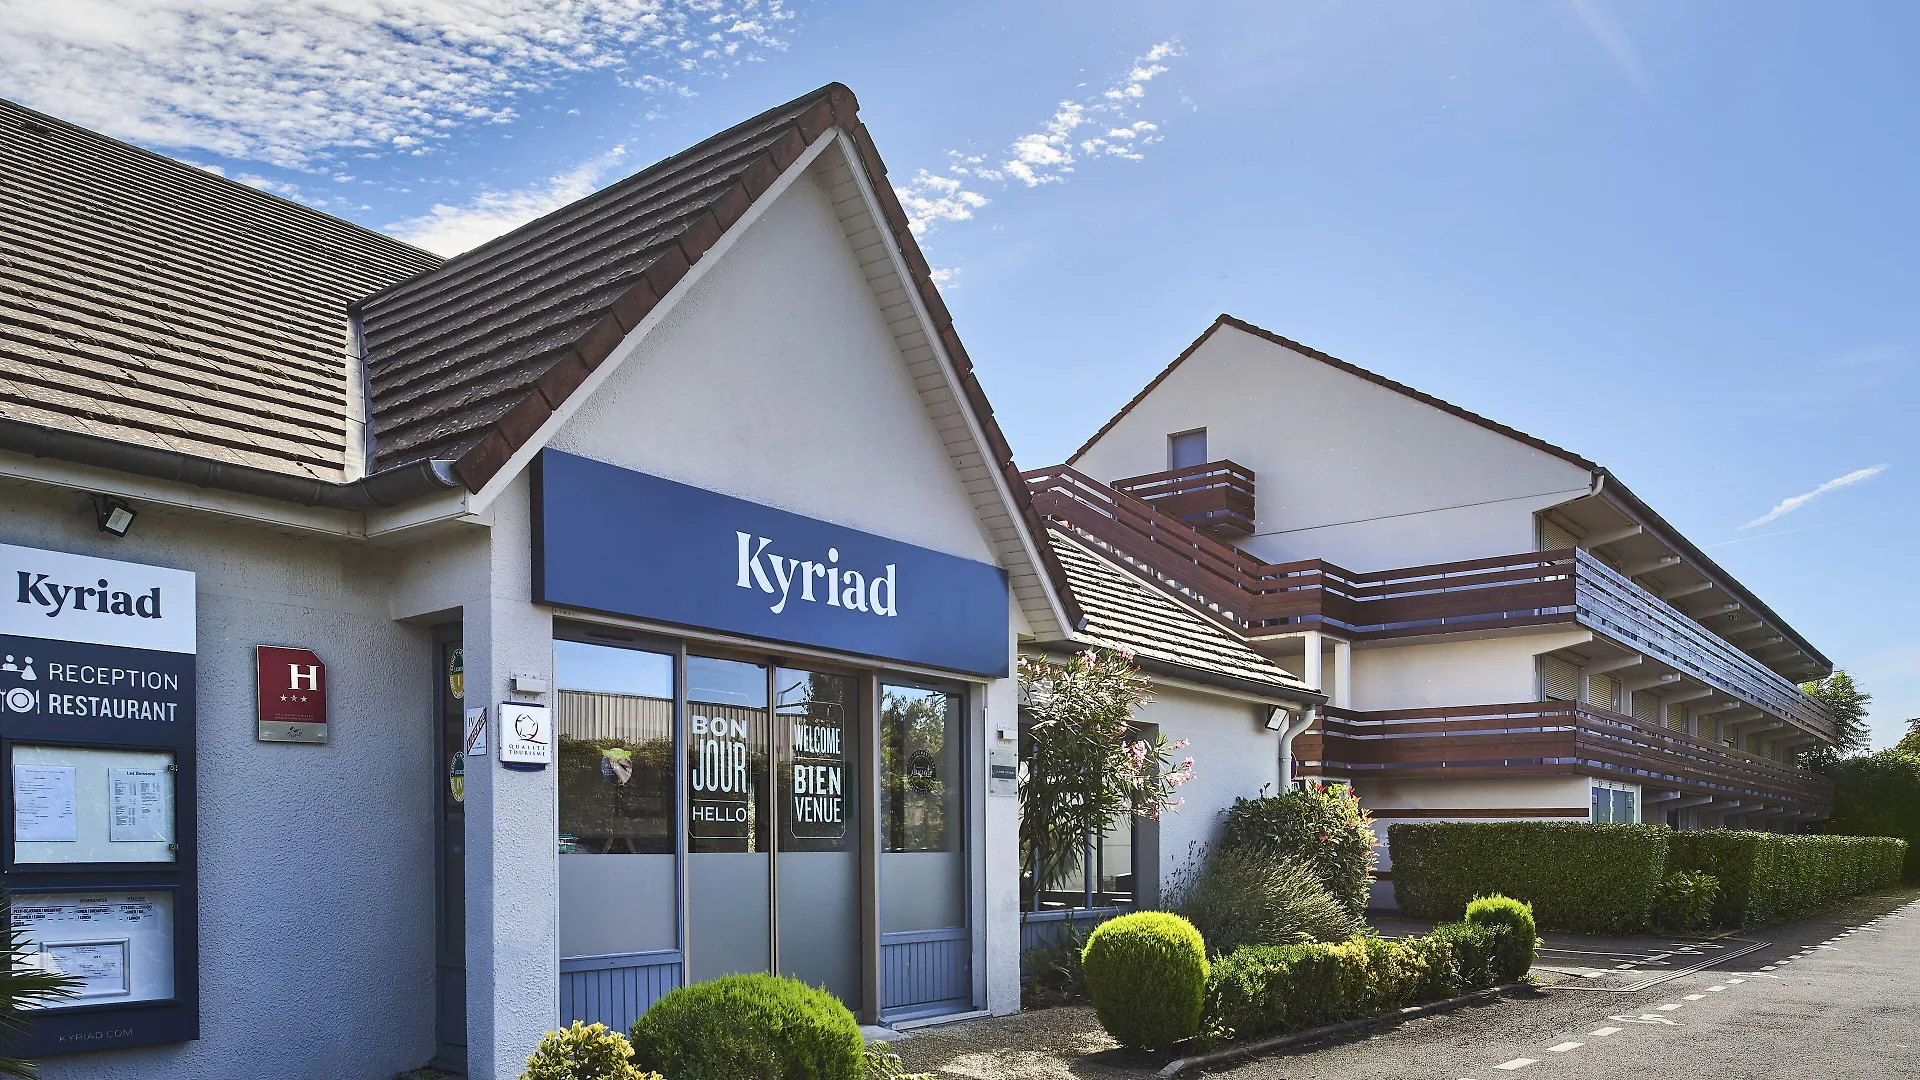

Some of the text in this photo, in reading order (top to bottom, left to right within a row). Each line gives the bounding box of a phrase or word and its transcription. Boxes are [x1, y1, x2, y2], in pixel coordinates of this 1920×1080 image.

[736, 531, 897, 617] Kyriad
[16, 571, 163, 619] Kyriad
[49, 662, 178, 691] RECEPTION
[287, 663, 320, 691] H
[48, 693, 178, 722] RESTAURANT
[692, 714, 747, 739] BON
[794, 724, 841, 755] WELCOME
[692, 739, 747, 794] JOUR
[794, 764, 841, 796] BIEN
[692, 806, 747, 823] HELLO
[794, 797, 842, 823] VENUE
